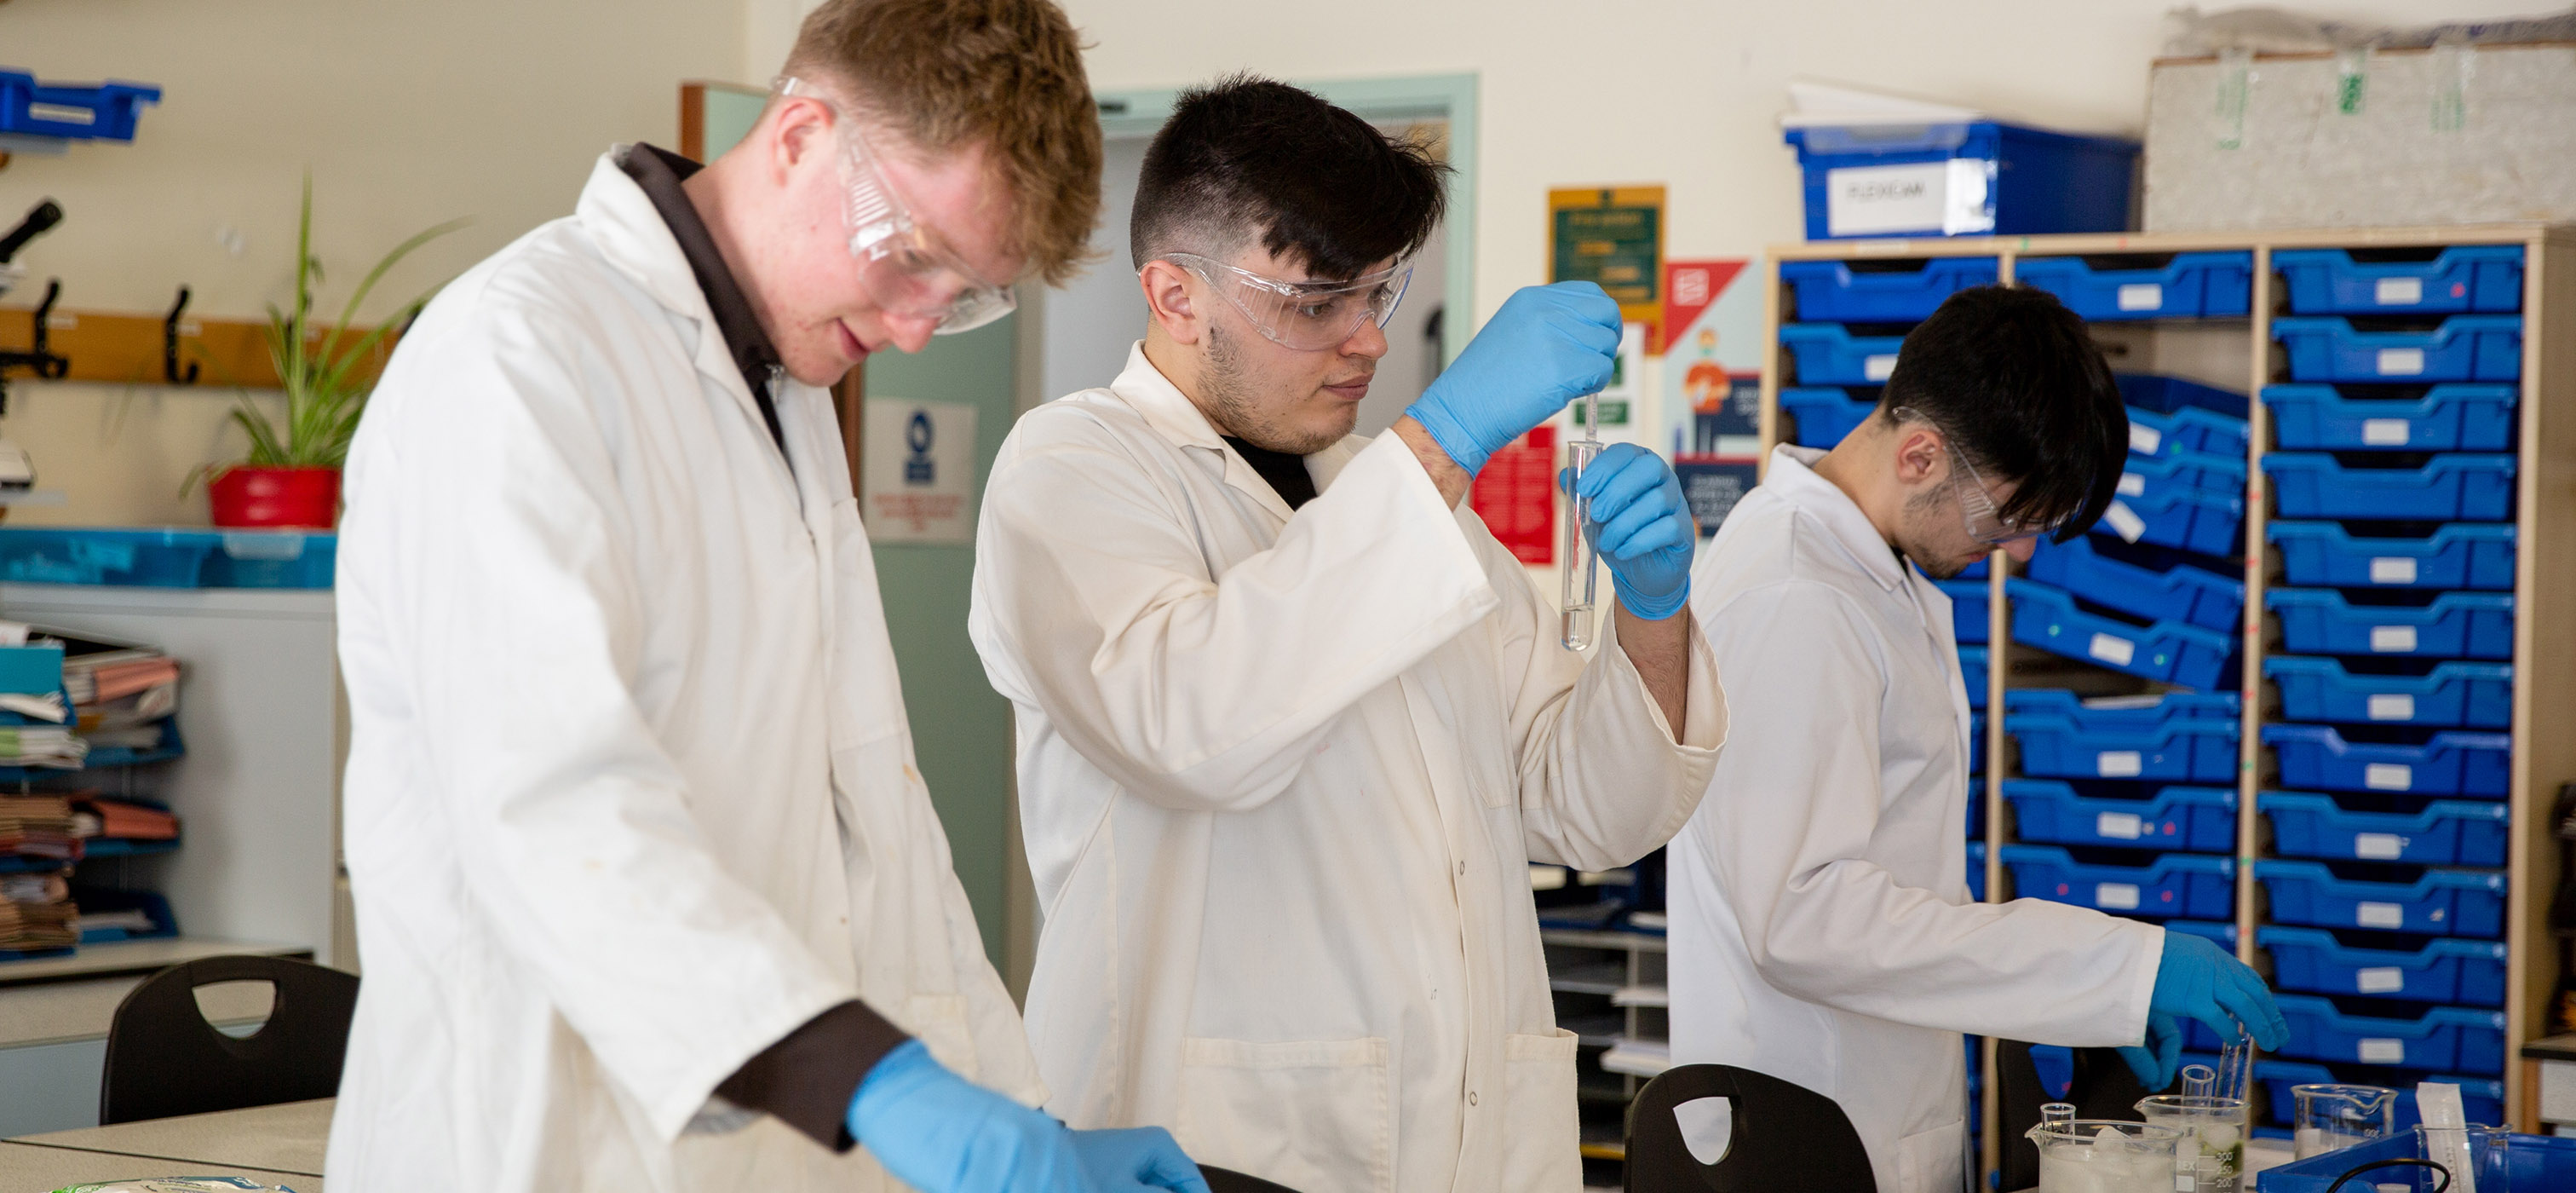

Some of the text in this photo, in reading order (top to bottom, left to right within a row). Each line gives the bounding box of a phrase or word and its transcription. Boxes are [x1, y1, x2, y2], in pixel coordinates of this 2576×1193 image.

[2217, 1152, 2234, 1161] 300
[2217, 1165, 2233, 1174] 250
[2217, 1178, 2233, 1188] 200
